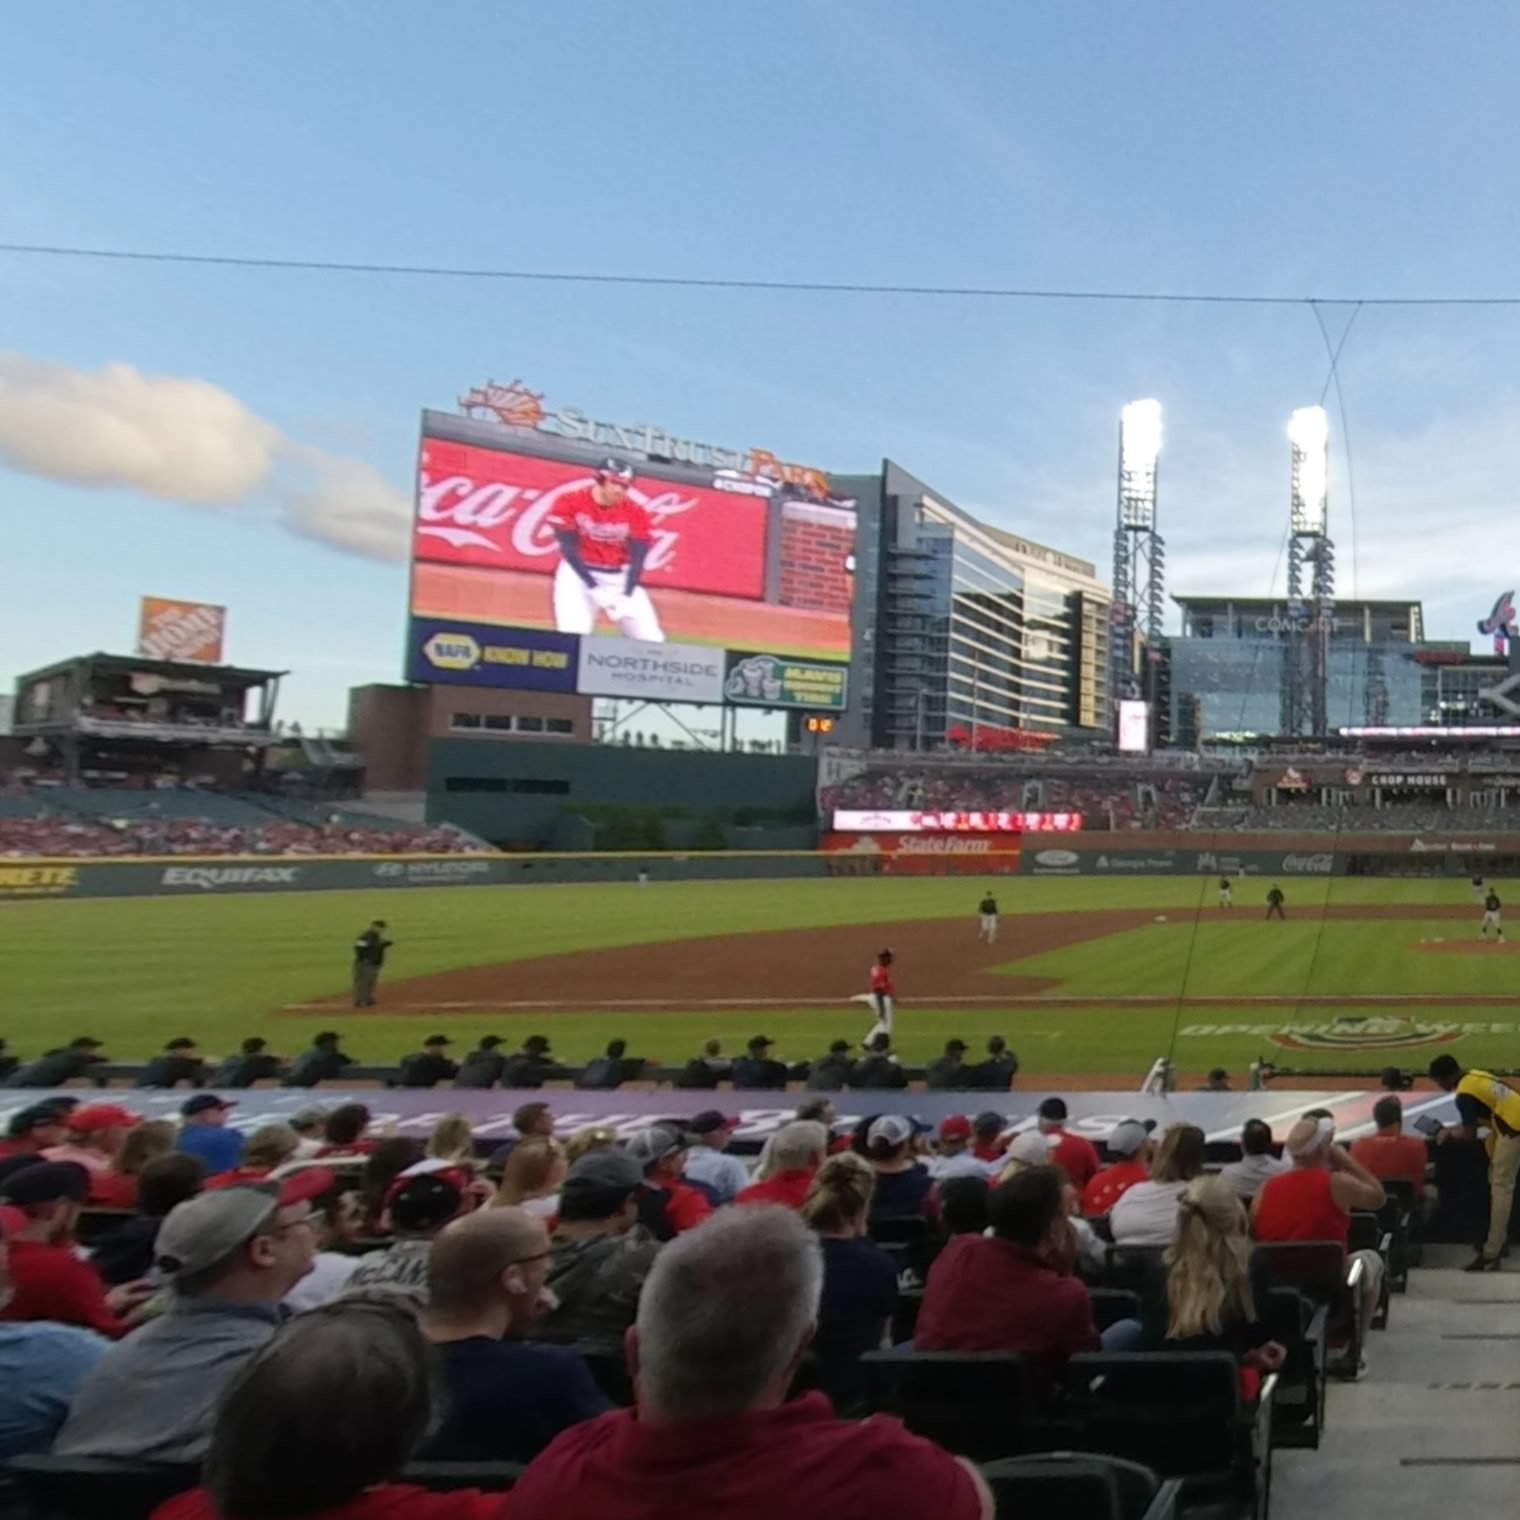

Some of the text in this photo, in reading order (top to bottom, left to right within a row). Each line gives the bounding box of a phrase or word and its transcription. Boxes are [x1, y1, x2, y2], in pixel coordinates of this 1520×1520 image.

[587, 652, 719, 678] NORTHSIDE
[611, 670, 694, 688] HOSPITAL
[1407, 775, 1447, 785] HOUSE
[161, 867, 294, 888] EQUIFAX
